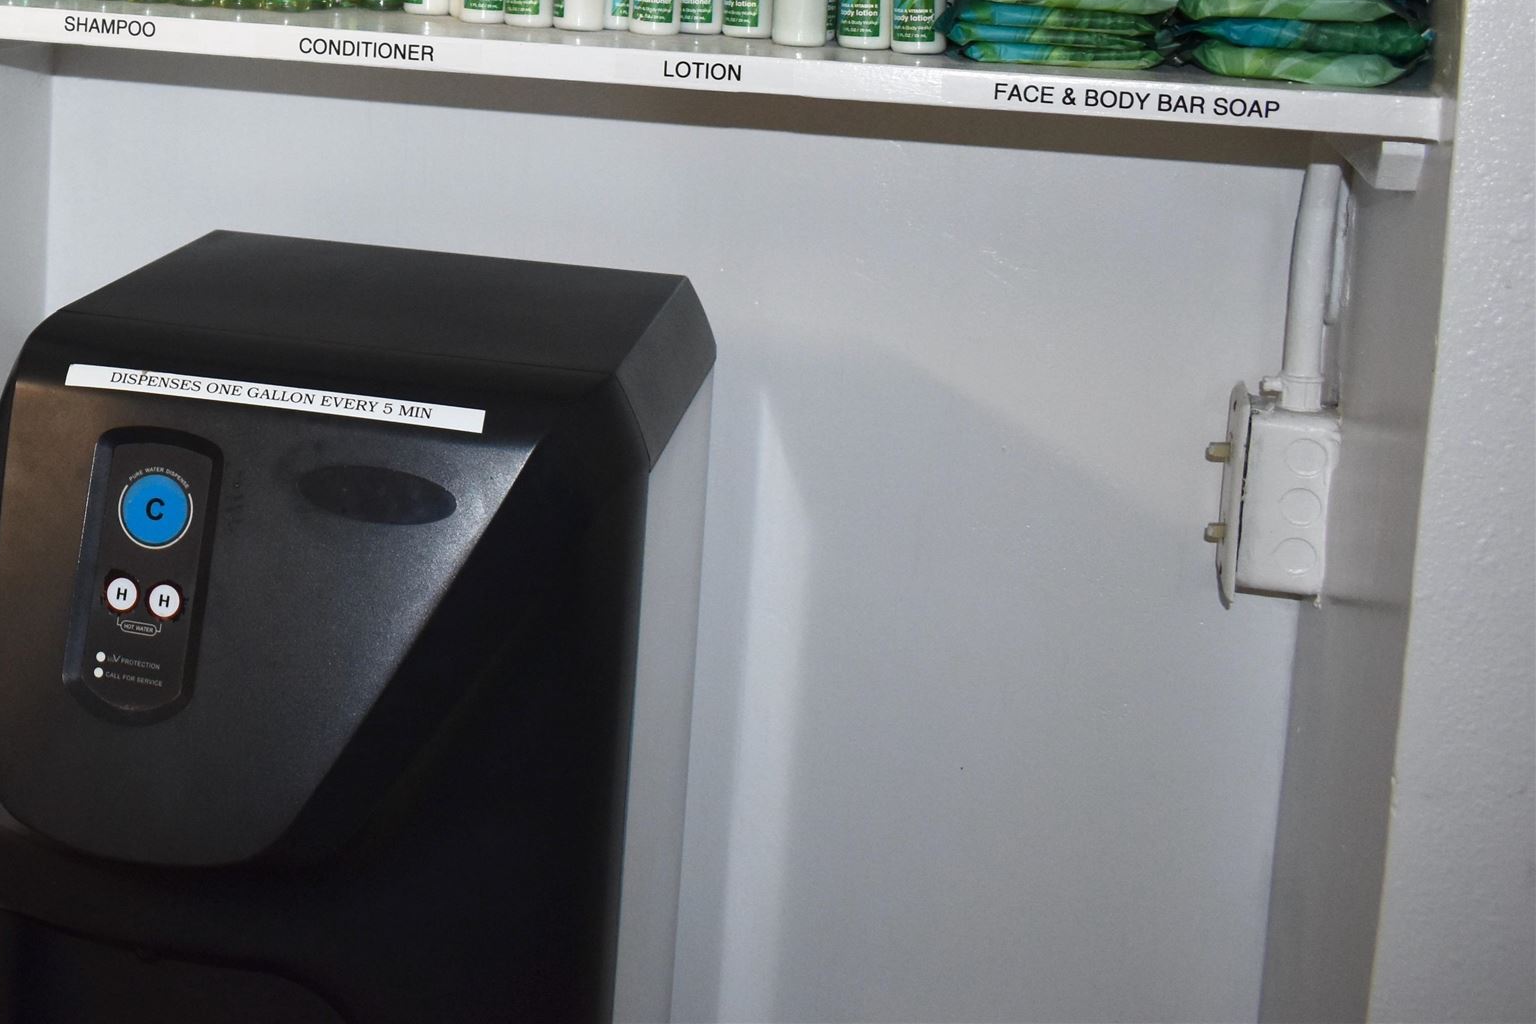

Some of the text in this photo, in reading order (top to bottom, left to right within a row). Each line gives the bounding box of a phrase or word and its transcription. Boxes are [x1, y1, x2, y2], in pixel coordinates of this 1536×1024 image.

[64, 16, 156, 37] SHAMPOO
[299, 37, 434, 62] CONDITIONER
[664, 60, 741, 81] LOTION
[994, 83, 1281, 118] FACE & BODY BAR SOAP
[110, 371, 433, 420] DISPENSES ONE GALLON EVERY 5 MIN
[128, 469, 143, 481] PURE
[165, 469, 190, 490] DISPENSE
[145, 497, 165, 521] C
[116, 587, 127, 601] H
[158, 594, 170, 608] H
[123, 623, 154, 634] HOT WATER
[121, 657, 161, 670] PROTECTION
[105, 670, 163, 687] CALL FOR SERVICE
